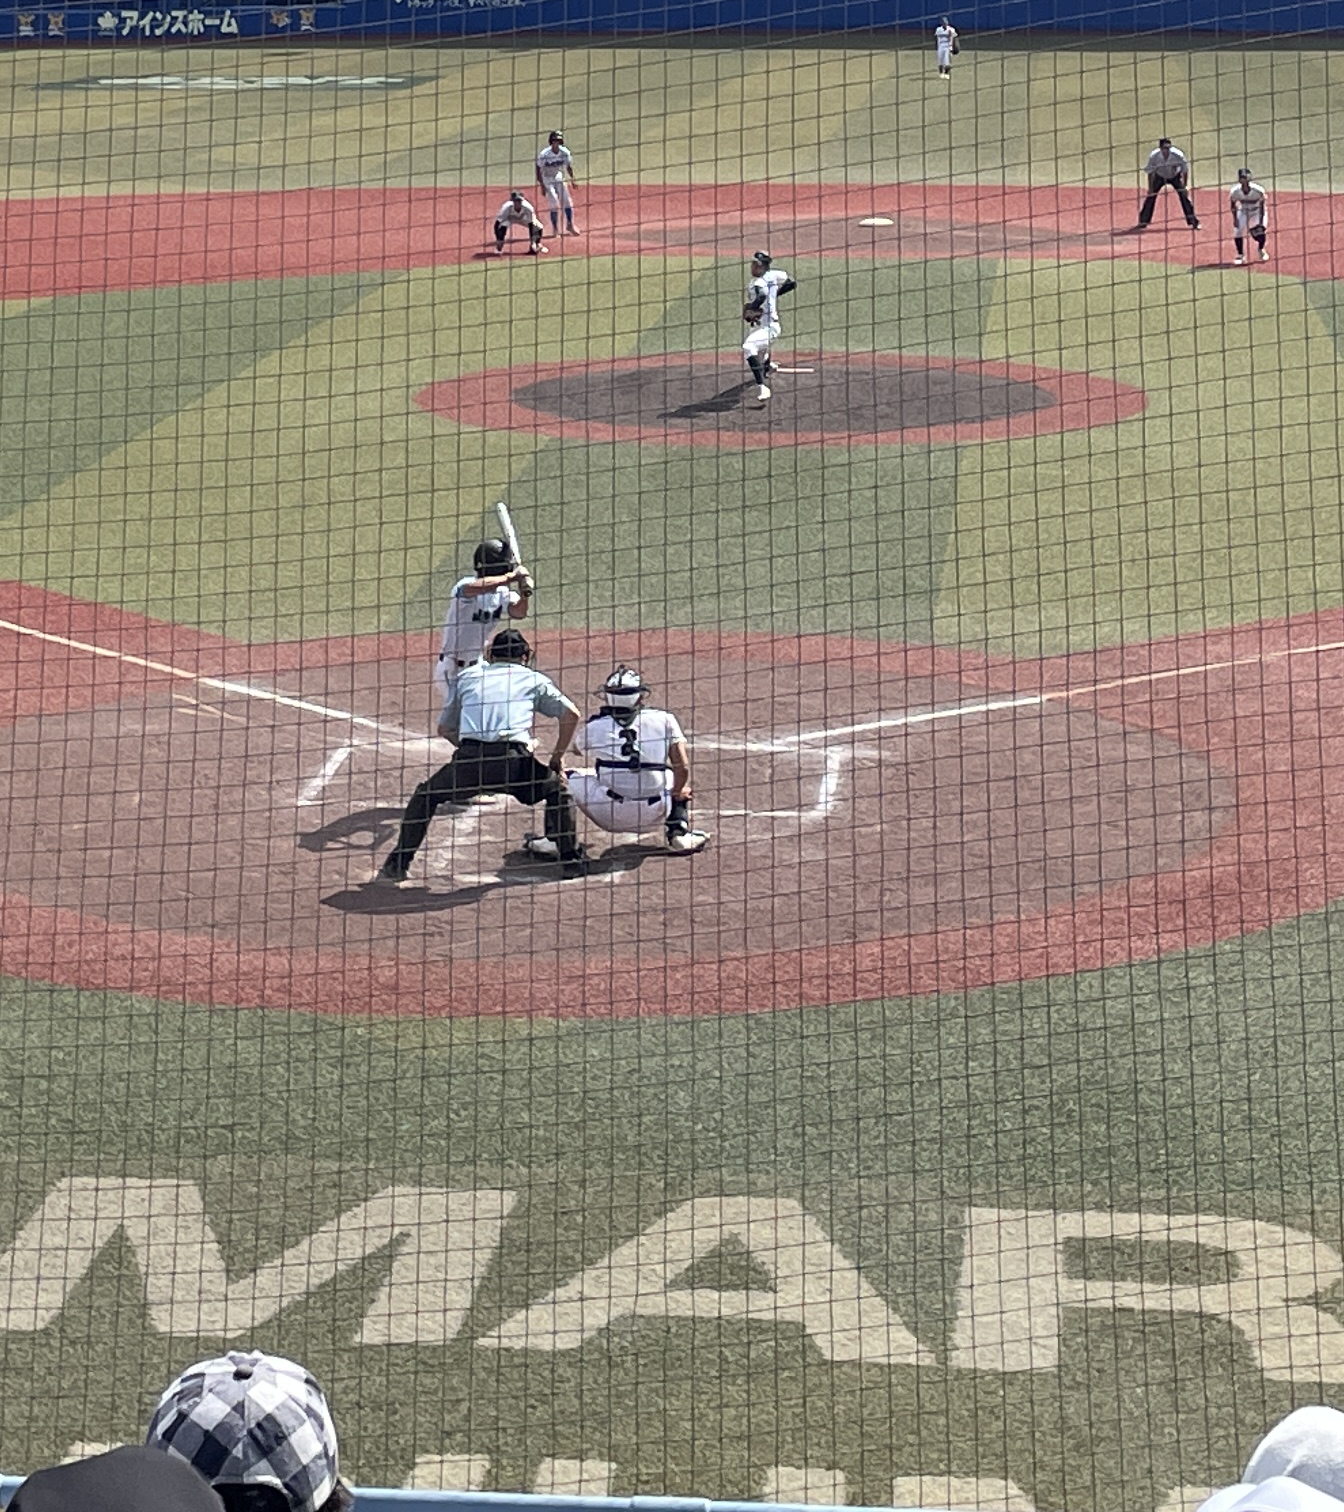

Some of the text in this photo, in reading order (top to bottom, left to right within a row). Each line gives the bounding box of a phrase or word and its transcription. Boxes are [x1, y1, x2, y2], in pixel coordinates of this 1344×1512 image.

[121, 9, 238, 36] アインズホーム
